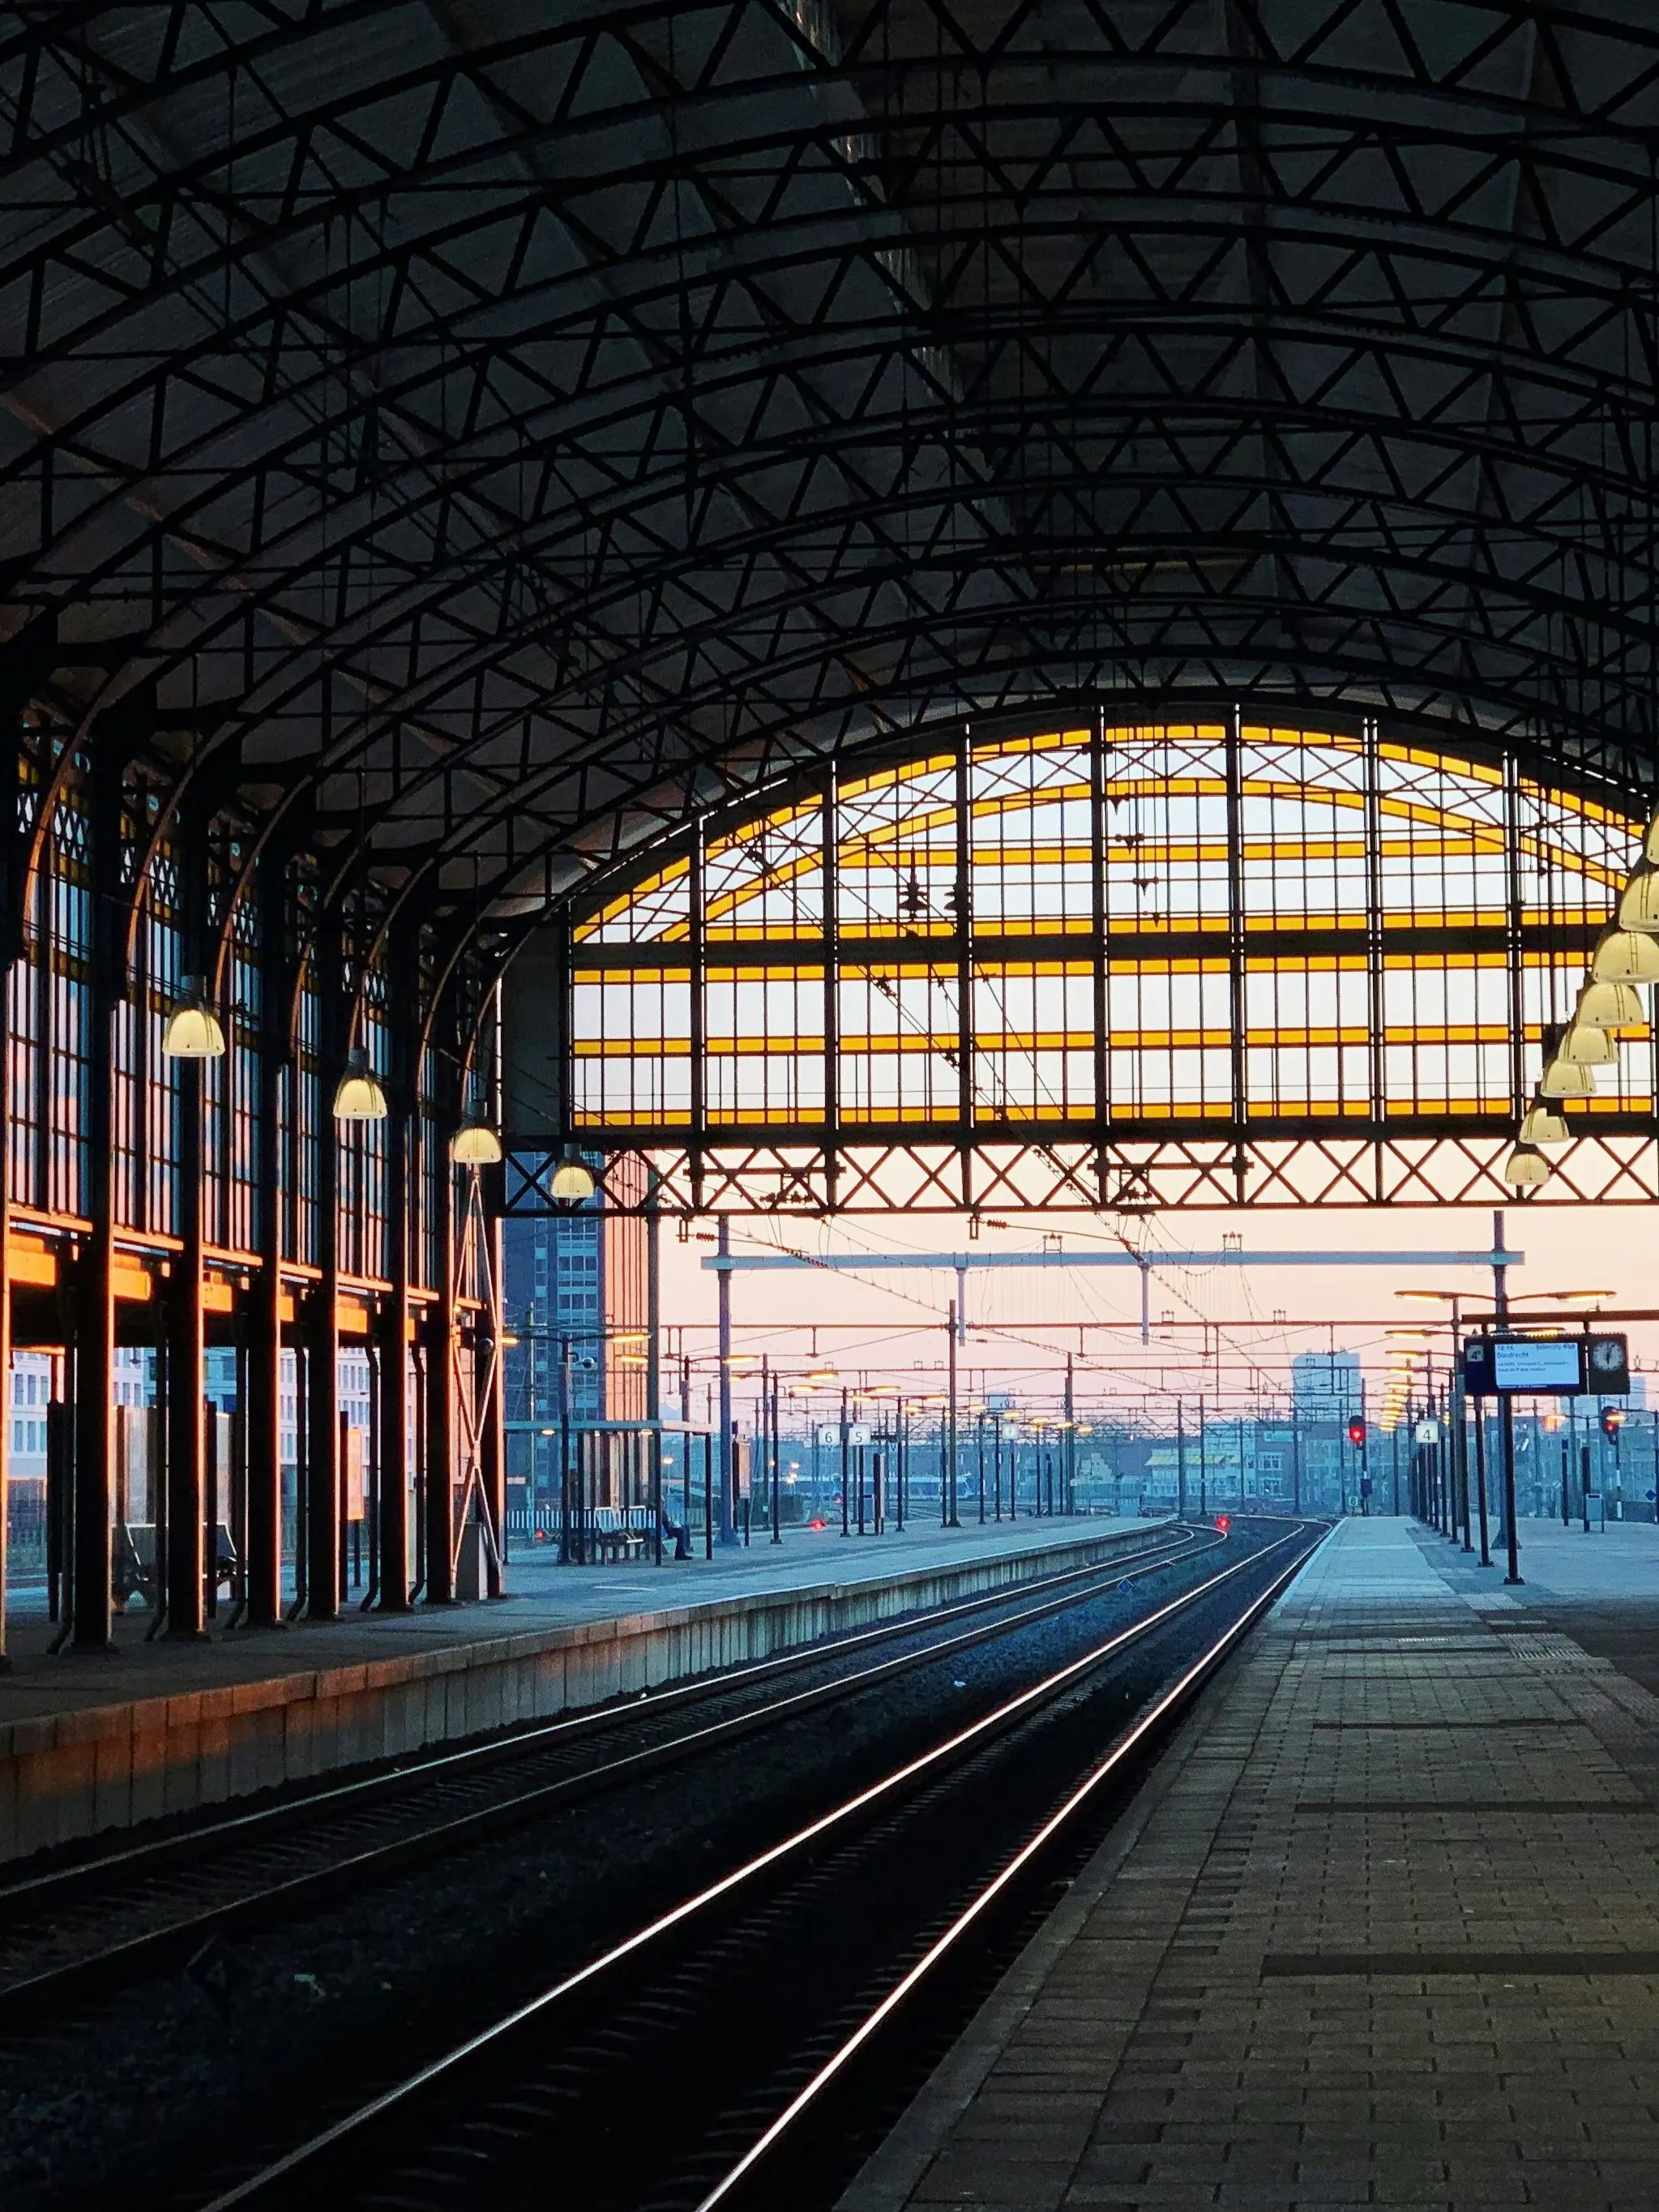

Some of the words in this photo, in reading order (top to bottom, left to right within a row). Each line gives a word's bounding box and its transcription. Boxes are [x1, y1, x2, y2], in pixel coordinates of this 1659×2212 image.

[1496, 1351, 1529, 1359] Dordrecht
[825, 1431, 832, 1444] 6
[855, 1431, 863, 1443] 5
[1423, 1429, 1431, 1441] 4
